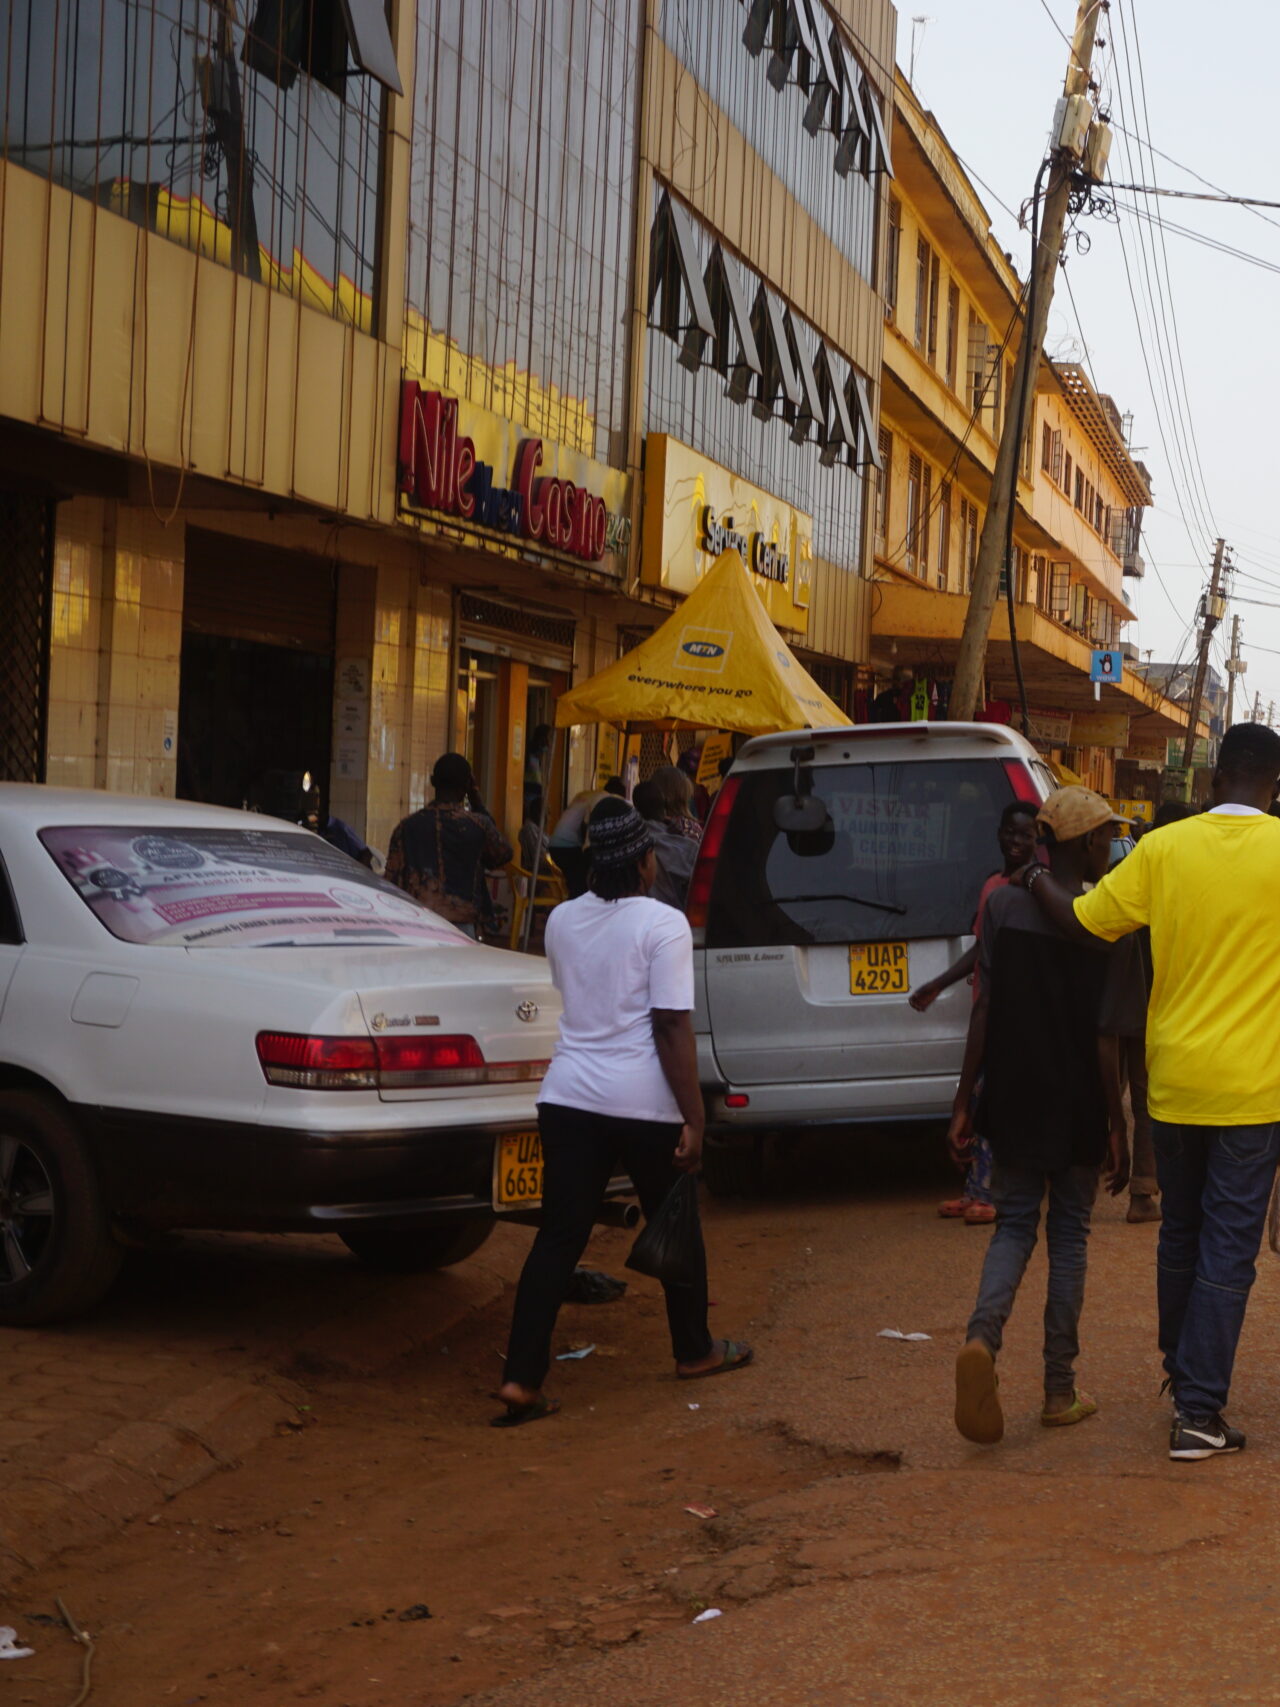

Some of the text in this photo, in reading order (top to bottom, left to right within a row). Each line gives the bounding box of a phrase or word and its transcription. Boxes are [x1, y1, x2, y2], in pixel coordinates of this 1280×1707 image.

[400, 380, 476, 517] Nile
[689, 643, 717, 656] MTN
[627, 673, 753, 698] everywhere you go
[860, 840, 938, 858] CLEANERS
[867, 945, 905, 966] UAP
[855, 969, 904, 991] 429J
[518, 1135, 543, 1163] UA
[506, 1167, 543, 1197] 663
